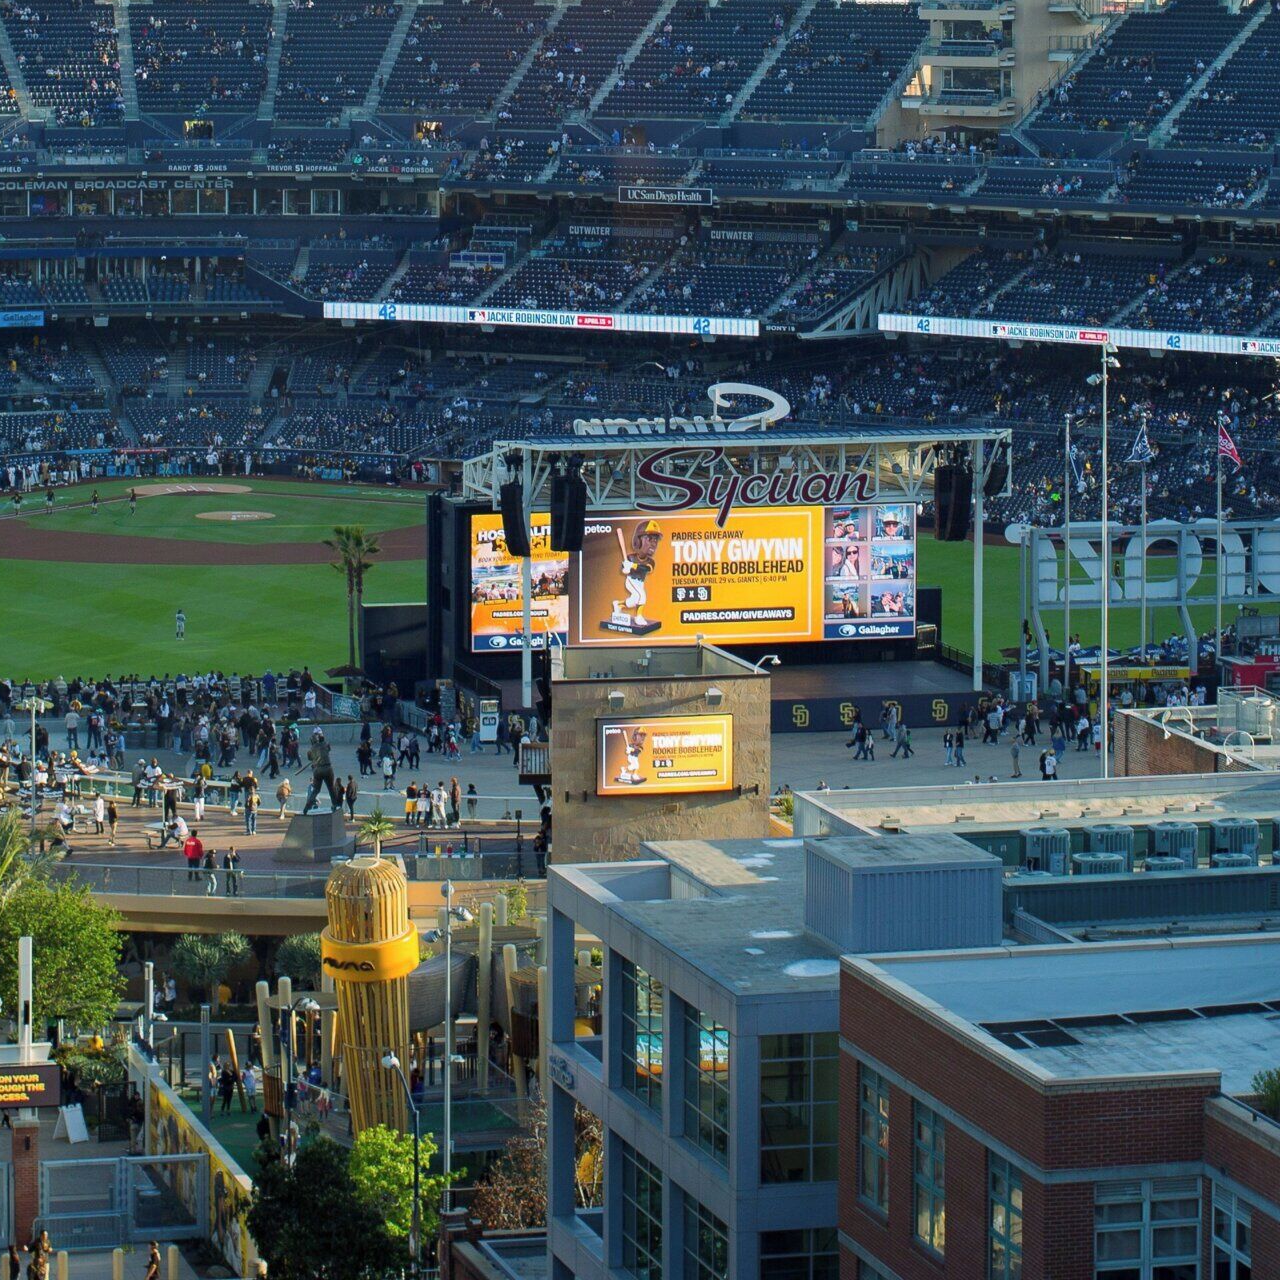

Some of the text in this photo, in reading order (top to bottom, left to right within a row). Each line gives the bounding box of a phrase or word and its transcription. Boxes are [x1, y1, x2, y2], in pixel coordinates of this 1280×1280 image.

[295, 164, 304, 172] 51
[74, 180, 168, 190] BROADCAST
[174, 179, 234, 189] CENTER
[628, 189, 702, 203] UC San Diego Health
[569, 225, 610, 236] CUTWATER
[710, 230, 753, 241] CUTWATER
[378, 304, 396, 320] 42
[486, 311, 514, 322] JACKIE
[515, 312, 558, 324] ROBINSON
[559, 315, 575, 325] DAY
[693, 318, 710, 335] 42
[917, 319, 930, 332] 42
[1007, 325, 1028, 337] JACKIE
[1029, 327, 1064, 339] ROBINSON
[1065, 329, 1078, 340] DAY
[1166, 335, 1181, 349] 42
[1258, 342, 1280, 353] JACKIE
[634, 445, 878, 528] Sycuan
[584, 524, 612, 535] petco
[671, 530, 744, 541] PADRES GIVEAWAY
[671, 537, 804, 564] TONY GWYNN
[672, 559, 804, 576] ROOKIE BOBBLEHEAD
[672, 577, 700, 586] TUESDAY,
[700, 577, 717, 585] APRIL
[718, 576, 727, 584] 29
[737, 576, 759, 584] GIANTS
[763, 575, 776, 583] 6:40
[683, 609, 793, 621] PADRES.COM/GIVEAWAYS
[858, 625, 900, 635] Gallagher
[652, 745, 723, 755] ROOKIE BOBBLEHEAD
[13, 1074, 39, 1083] YOUR
[26, 1083, 45, 1091] THE
